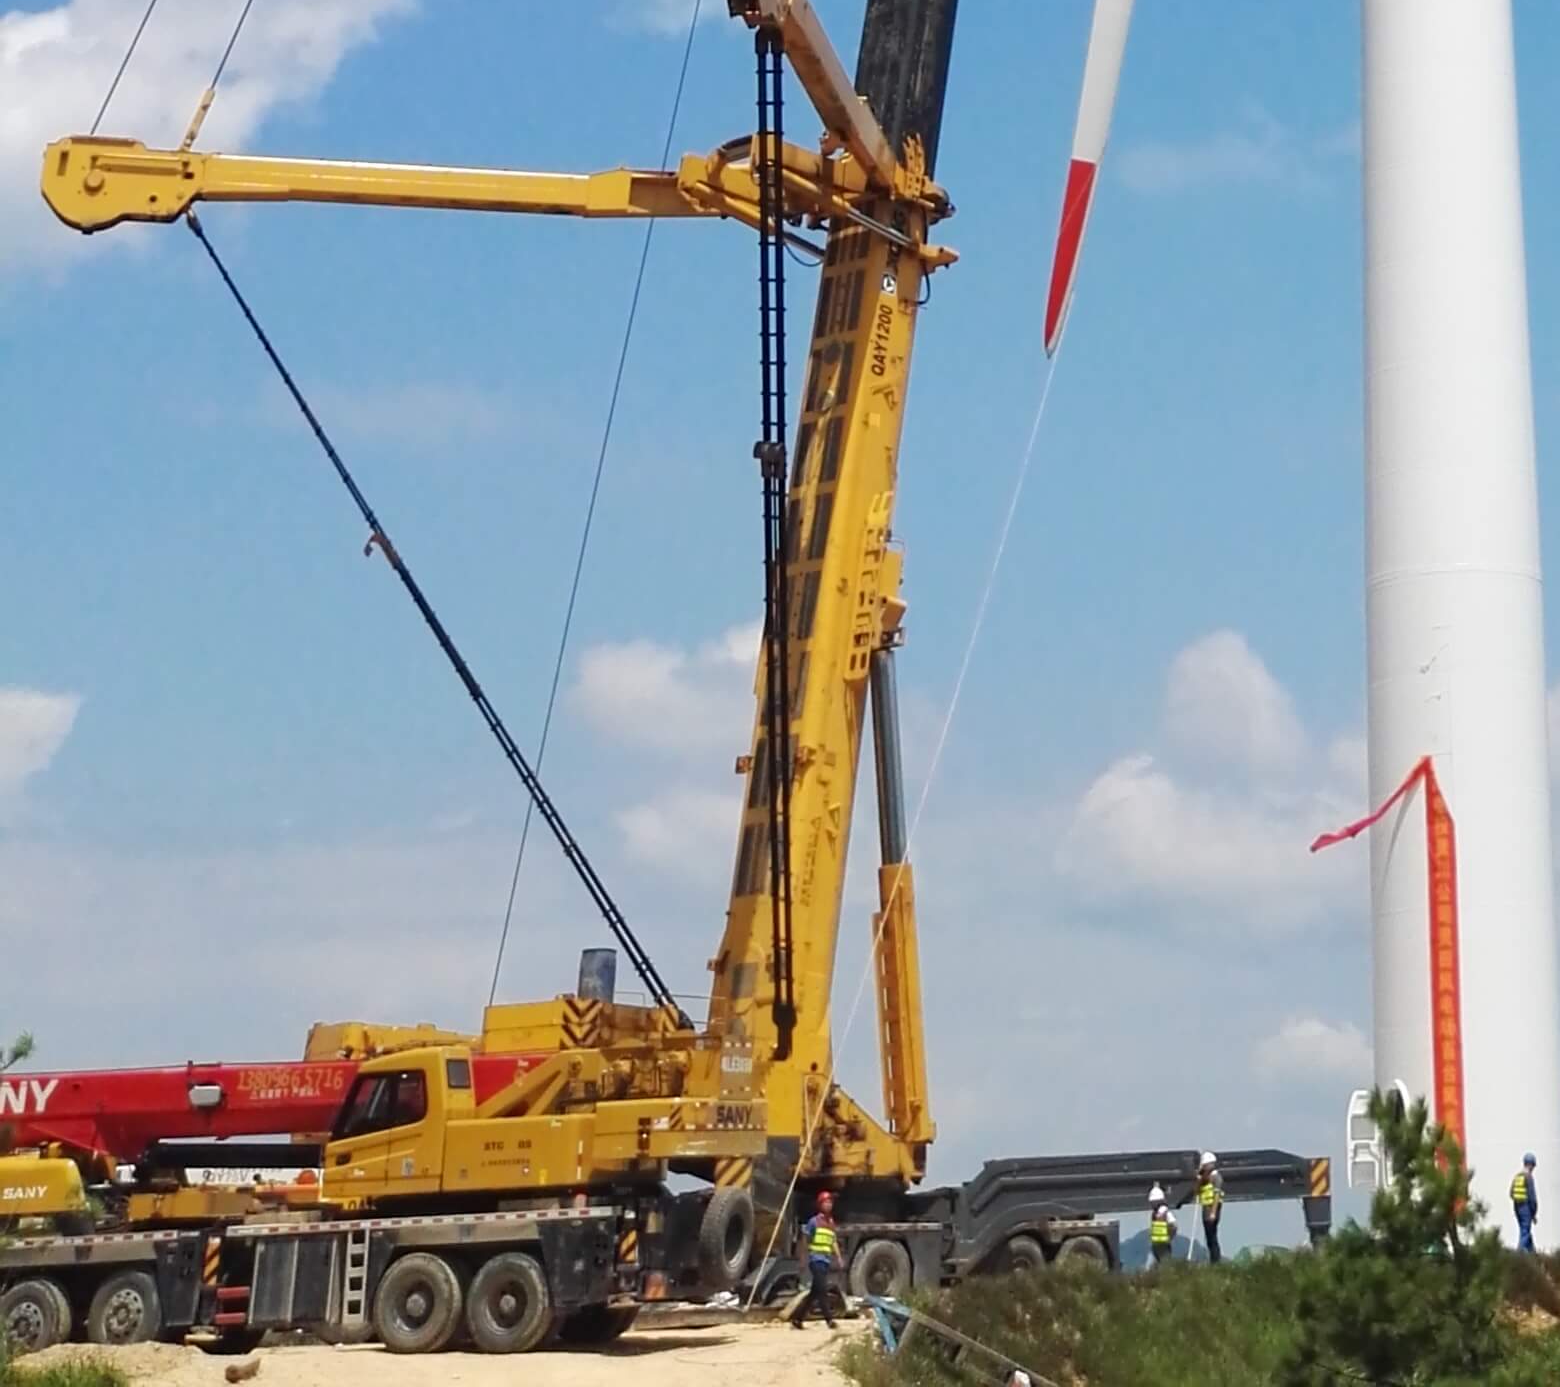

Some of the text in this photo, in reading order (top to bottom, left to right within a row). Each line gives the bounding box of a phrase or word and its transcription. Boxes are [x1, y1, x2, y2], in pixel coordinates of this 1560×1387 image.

[871, 304, 893, 376] QAY1200
[717, 1106, 752, 1123] SANY
[3, 1185, 48, 1200] SANY
